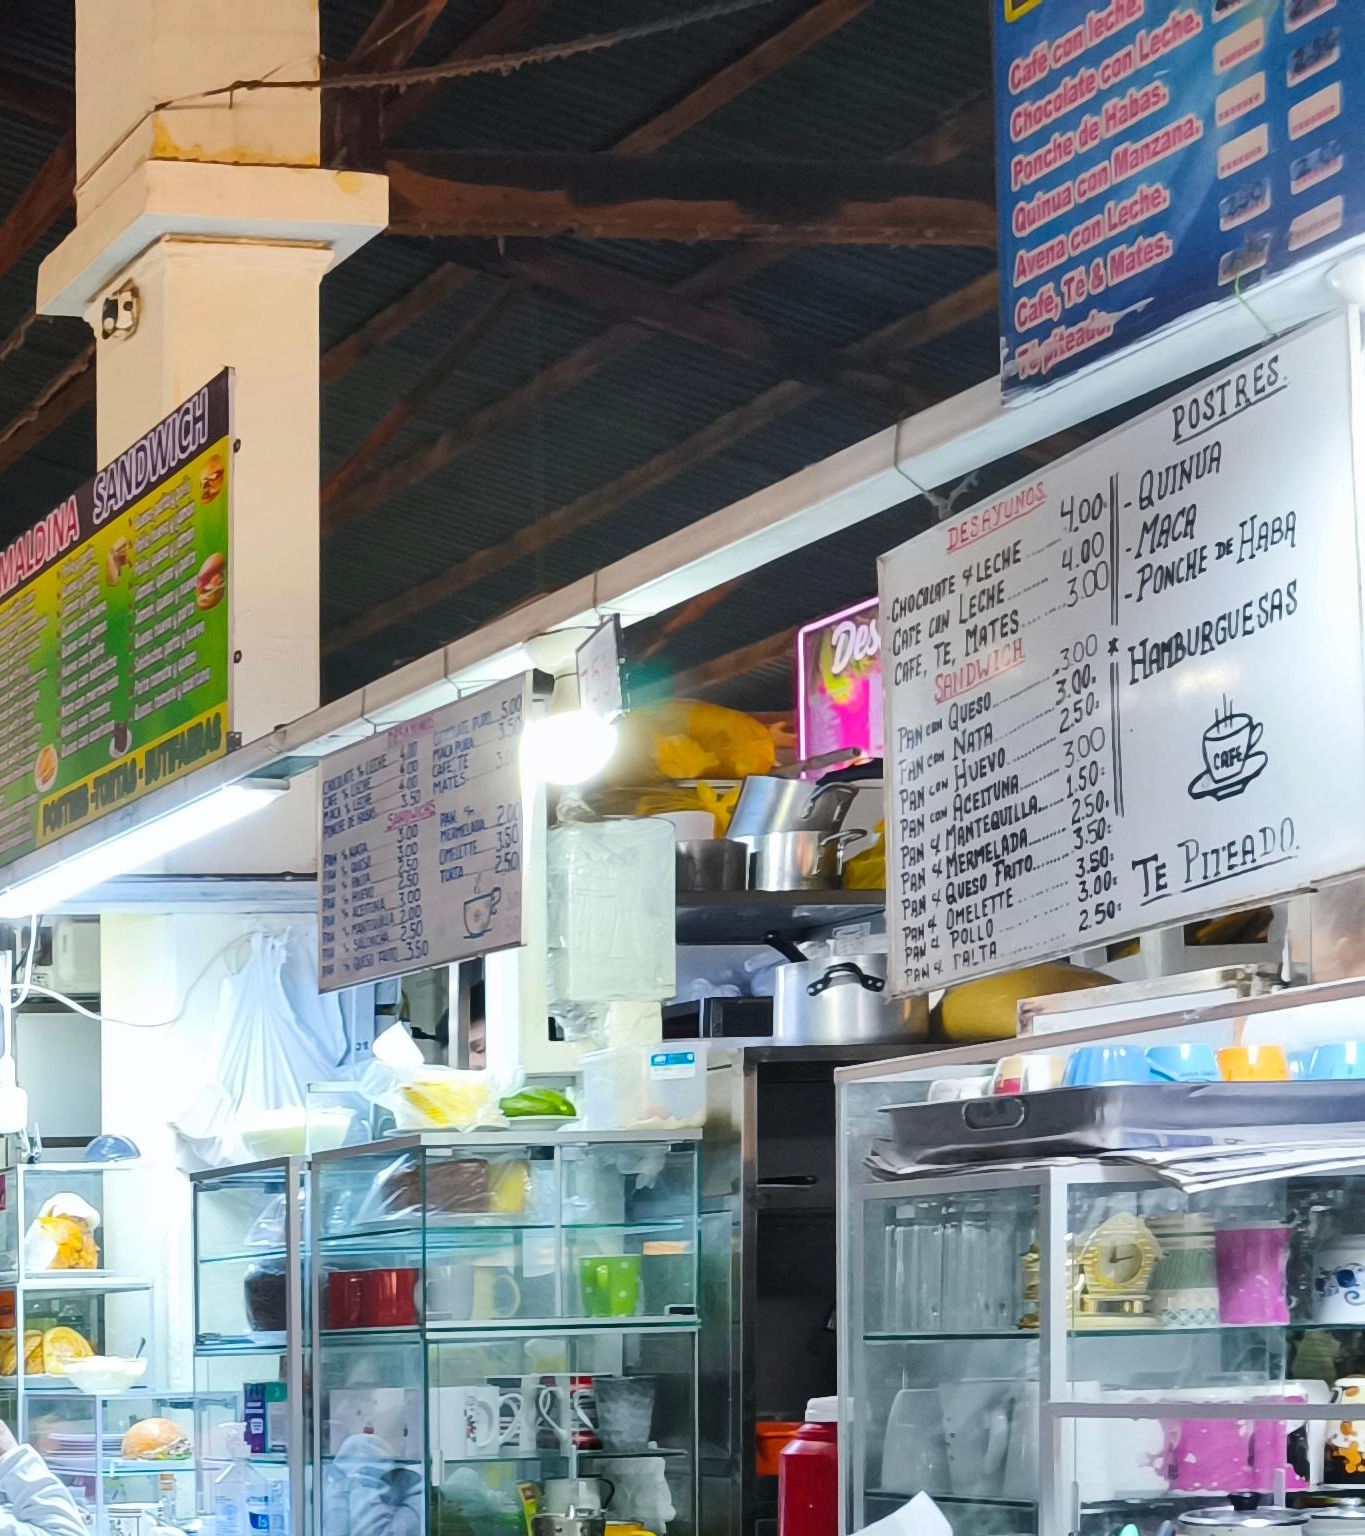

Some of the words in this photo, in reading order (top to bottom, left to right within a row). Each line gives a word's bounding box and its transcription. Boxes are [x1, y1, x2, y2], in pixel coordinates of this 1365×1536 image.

[1009, 50, 1048, 95] Café
[1051, 32, 1084, 70] con
[1010, 67, 1097, 142] Chocolate
[1101, 45, 1133, 84] con
[1137, 10, 1203, 65] Leche.
[1011, 124, 1074, 189] Ponche
[1077, 110, 1100, 145] de
[1105, 81, 1168, 129] Habas.
[1013, 181, 1072, 236] Quinua
[1075, 162, 1109, 203] con
[1113, 115, 1203, 173] Manzana.
[1013, 234, 1067, 285] Avena
[1069, 214, 1103, 254] con
[1107, 184, 1168, 230] Leche.
[1089, 258, 1106, 290] &
[1111, 234, 1172, 282] Mates.
[92, 385, 209, 525] SANDWICH
[1139, 441, 1222, 510] QUINUA
[947, 481, 1046, 551] DESAYUNOS
[1134, 503, 1197, 559] MACA
[891, 576, 955, 623] CHOCOLATE
[976, 539, 1022, 583] LECHE
[959, 579, 1005, 625] LECHE
[1062, 532, 1104, 571] 4.00
[1136, 545, 1207, 602] PONCHE
[1215, 537, 1234, 561] DE
[1237, 511, 1296, 564] HABA
[965, 609, 1019, 657] MATES
[1127, 579, 1298, 685] HAMBURGUESAS
[898, 725, 923, 752] PAN
[949, 692, 992, 731] QUESO
[953, 722, 993, 761] NATA
[433, 774, 466, 795] MATES
[899, 786, 925, 815] PAN
[954, 747, 1005, 792] HUEVO
[899, 812, 925, 842] PAN
[953, 774, 1019, 822] ACEITUNA
[1063, 726, 1105, 769] 3.00
[900, 841, 925, 869] PAN
[946, 795, 1038, 852] MANTEQUILLA
[900, 869, 926, 895] PAN
[946, 828, 1028, 879] MERMELADA
[901, 895, 926, 920] PAN
[945, 872, 987, 904] QUESO
[993, 854, 1033, 887] FRITO
[1132, 853, 1168, 897] TE
[902, 923, 925, 947] PAN
[946, 887, 1014, 930] OMELETTE
[904, 941, 927, 966] PAN
[949, 918, 993, 949] POLLO
[904, 962, 930, 984] PAN
